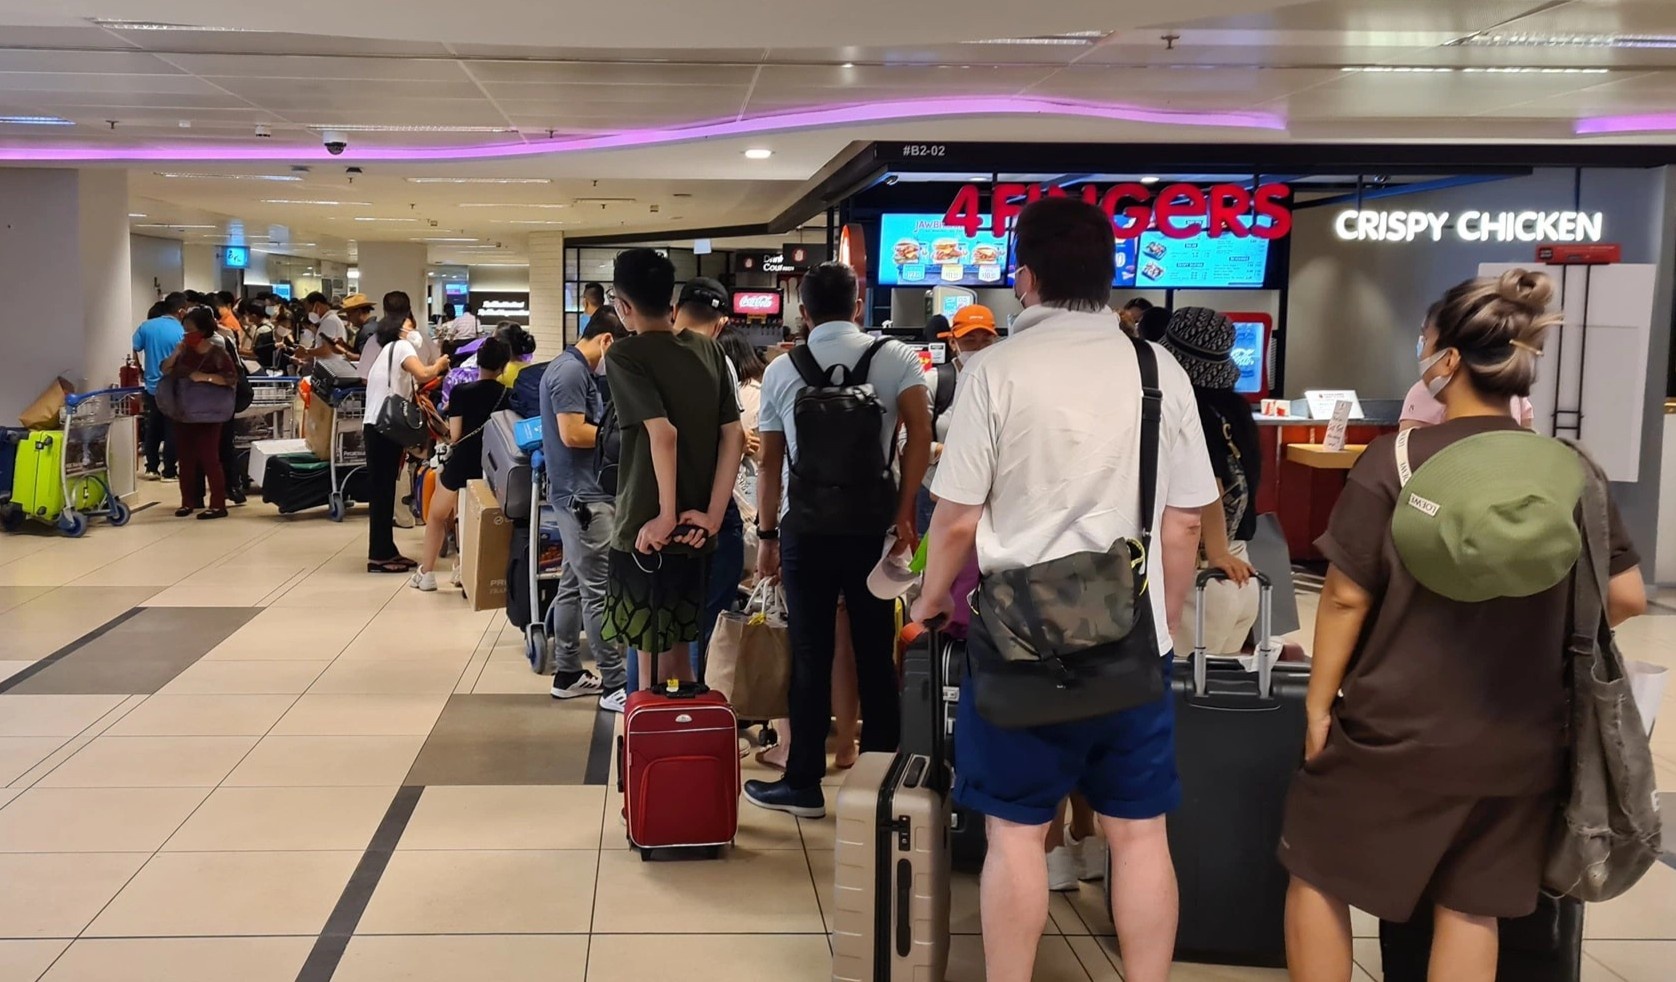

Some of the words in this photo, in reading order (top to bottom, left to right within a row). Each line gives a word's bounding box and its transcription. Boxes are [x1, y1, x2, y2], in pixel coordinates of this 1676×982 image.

[902, 145, 946, 157] #B2-02
[1335, 210, 1450, 242] CRISPY
[1456, 210, 1603, 242] CHICKEN
